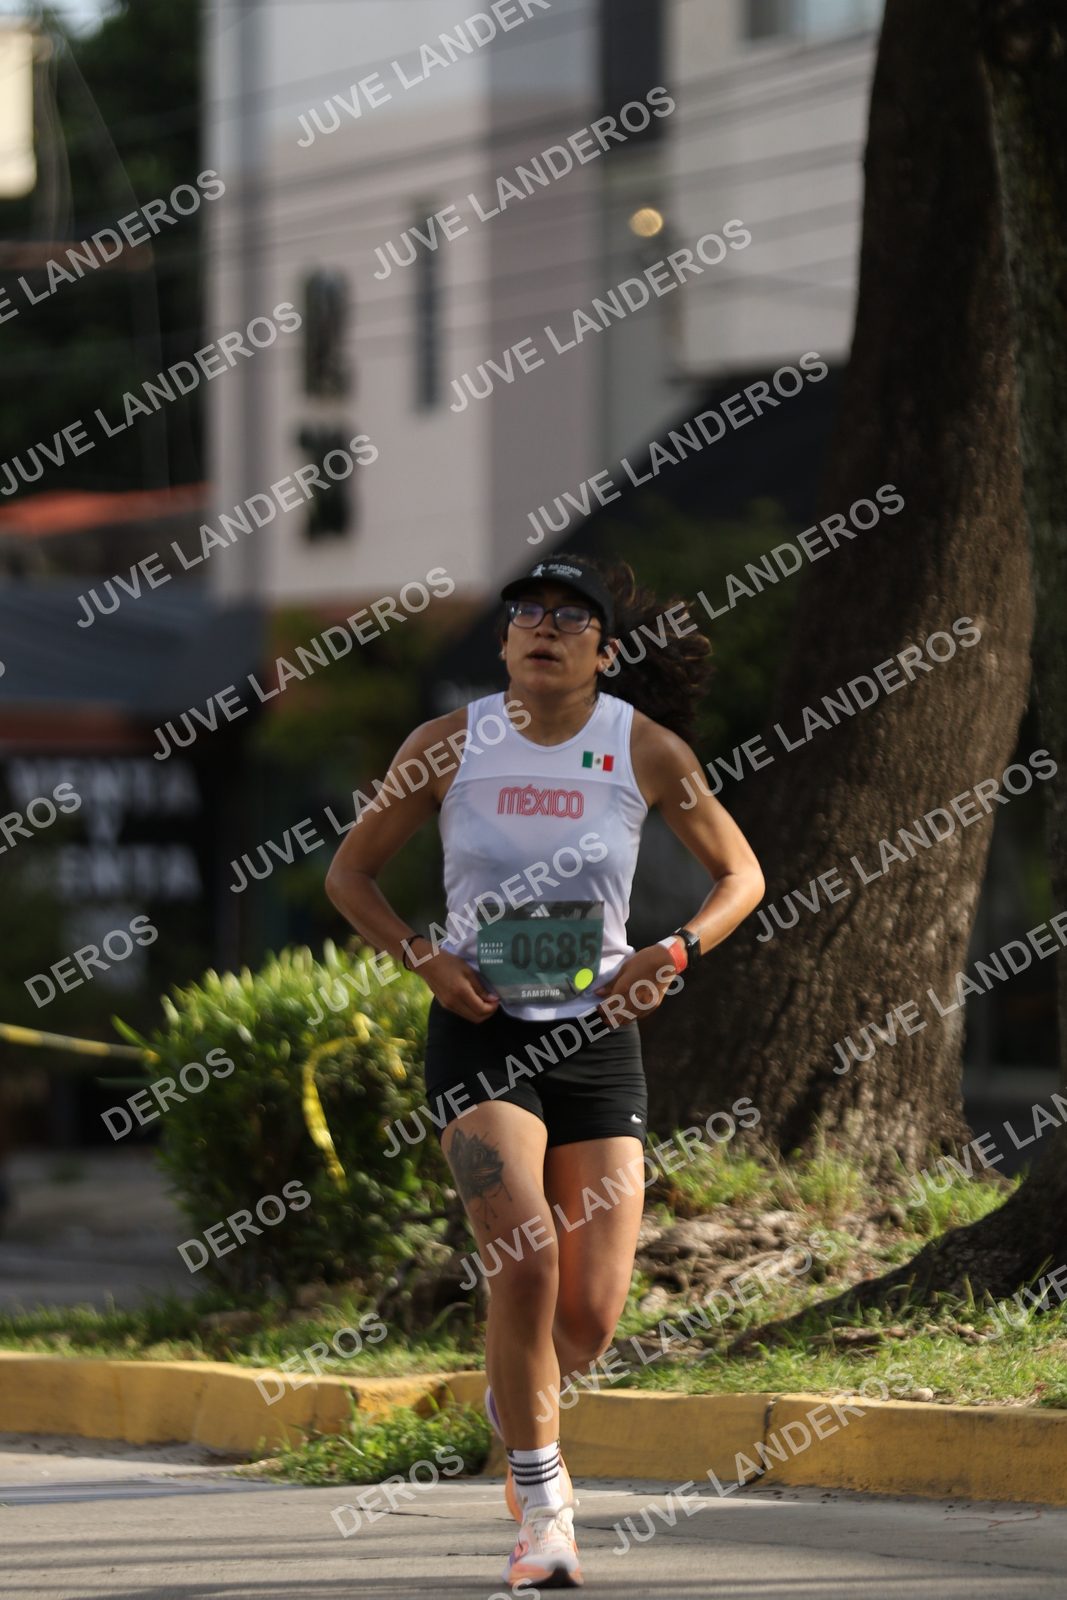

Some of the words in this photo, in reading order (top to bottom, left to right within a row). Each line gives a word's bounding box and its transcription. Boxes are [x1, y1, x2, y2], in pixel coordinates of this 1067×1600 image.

[497, 784, 584, 819] MÉXICO
[511, 931, 598, 971] 0685
[521, 989, 561, 998] SAMSUNG
